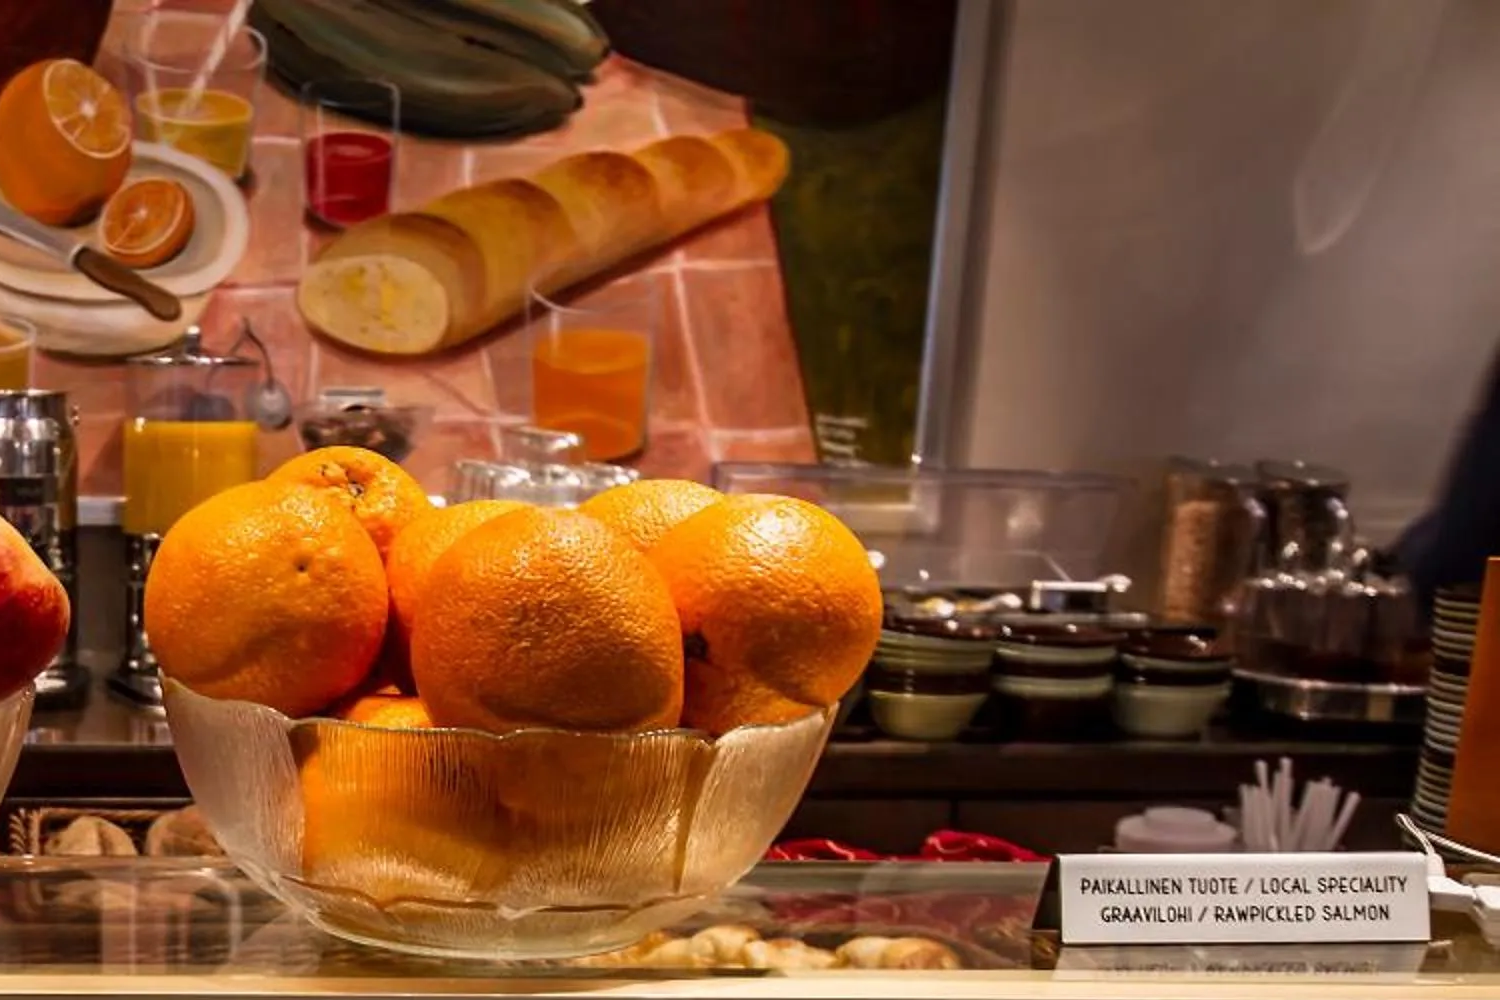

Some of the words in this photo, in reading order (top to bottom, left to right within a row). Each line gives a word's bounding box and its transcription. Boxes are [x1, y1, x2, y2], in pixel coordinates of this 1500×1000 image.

[1080, 877, 1183, 895] PAIKALLINEN
[1187, 877, 1238, 895] TUOTE
[1243, 878, 1254, 894] /
[1260, 877, 1311, 895] LOCAL
[1317, 875, 1408, 894] SPECIALITY
[1100, 905, 1193, 923] GRAAVILOHI
[1197, 906, 1208, 923] /
[1213, 905, 1317, 923] RAWPICKLED
[1321, 904, 1390, 921] SALMON
